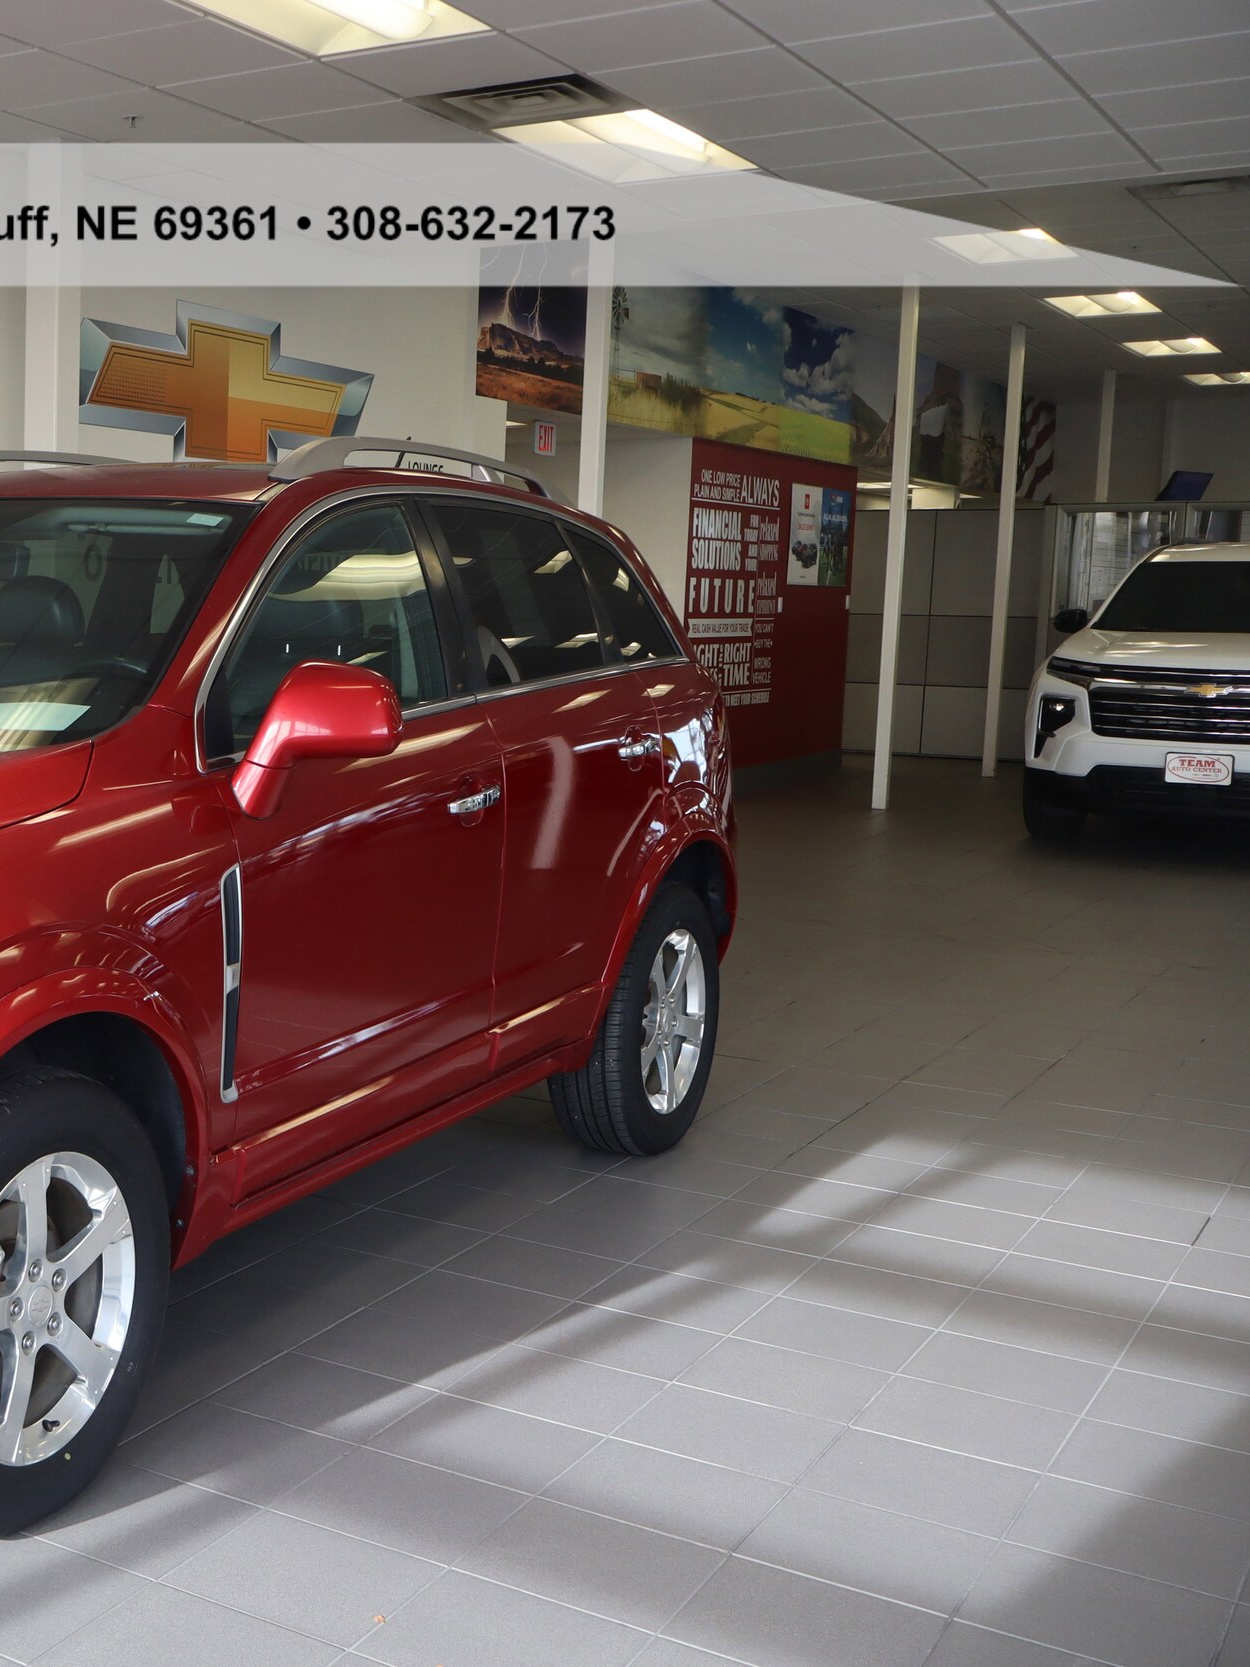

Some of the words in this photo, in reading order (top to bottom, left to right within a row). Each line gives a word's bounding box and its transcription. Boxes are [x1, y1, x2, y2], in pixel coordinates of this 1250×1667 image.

[538, 424, 554, 453] EXIT
[701, 469, 713, 484] ONE
[713, 471, 726, 486] LOW
[726, 473, 741, 488] PRICE
[694, 484, 709, 498] PLAIN
[710, 486, 721, 500] AND
[722, 488, 740, 502] SIMPLE
[741, 475, 780, 507] ALWAYS
[692, 507, 742, 540] FINANCIAL
[691, 538, 742, 570] SOLUTIONS
[689, 577, 755, 613] FUTURE
[724, 642, 752, 664] RIGHT
[754, 657, 771, 669] WRONG
[722, 663, 751, 687] TIME
[1179, 759, 1216, 768] TEAM
